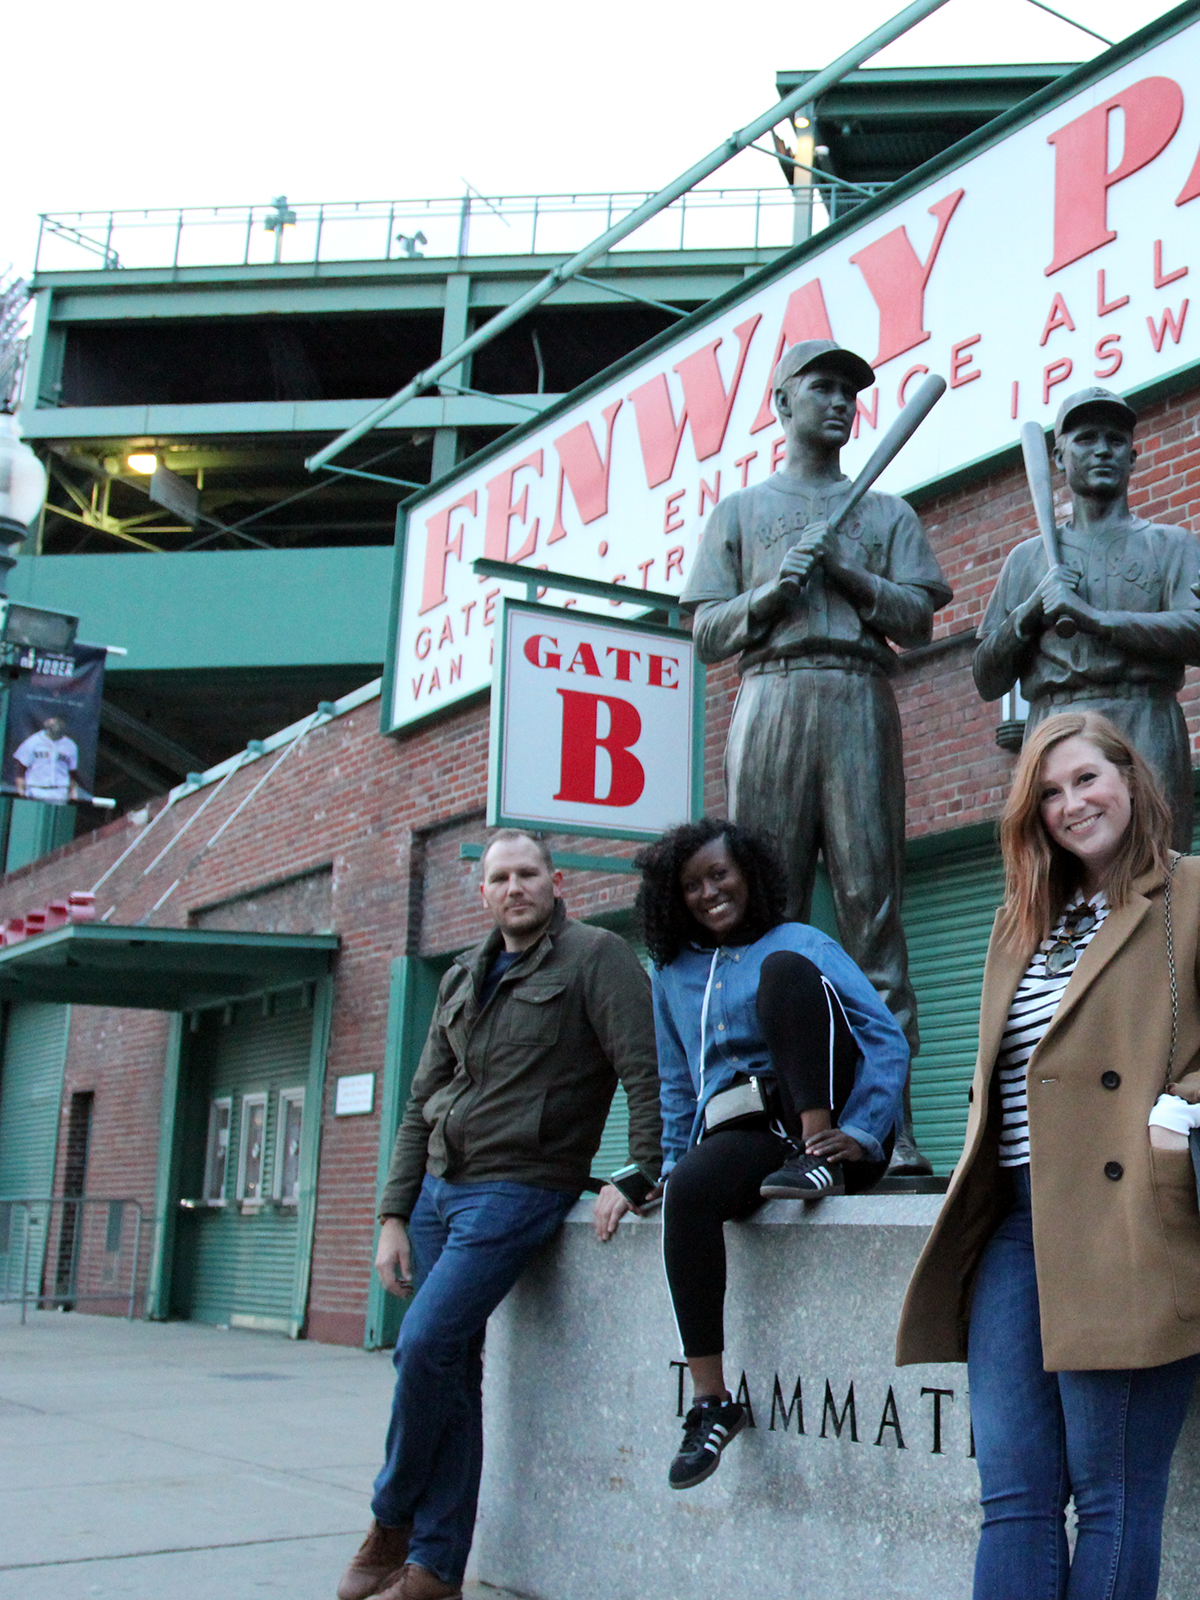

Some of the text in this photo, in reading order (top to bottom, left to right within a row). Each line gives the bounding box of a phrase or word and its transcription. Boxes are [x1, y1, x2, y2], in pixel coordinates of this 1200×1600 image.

[414, 587, 501, 661] GATE
[663, 332, 982, 534] ENTRNCE
[1039, 238, 1188, 347] ALL
[411, 653, 463, 701] VAN
[523, 634, 680, 690] GATE
[552, 687, 646, 809] B
[669, 1361, 976, 1458] TAMMAT
